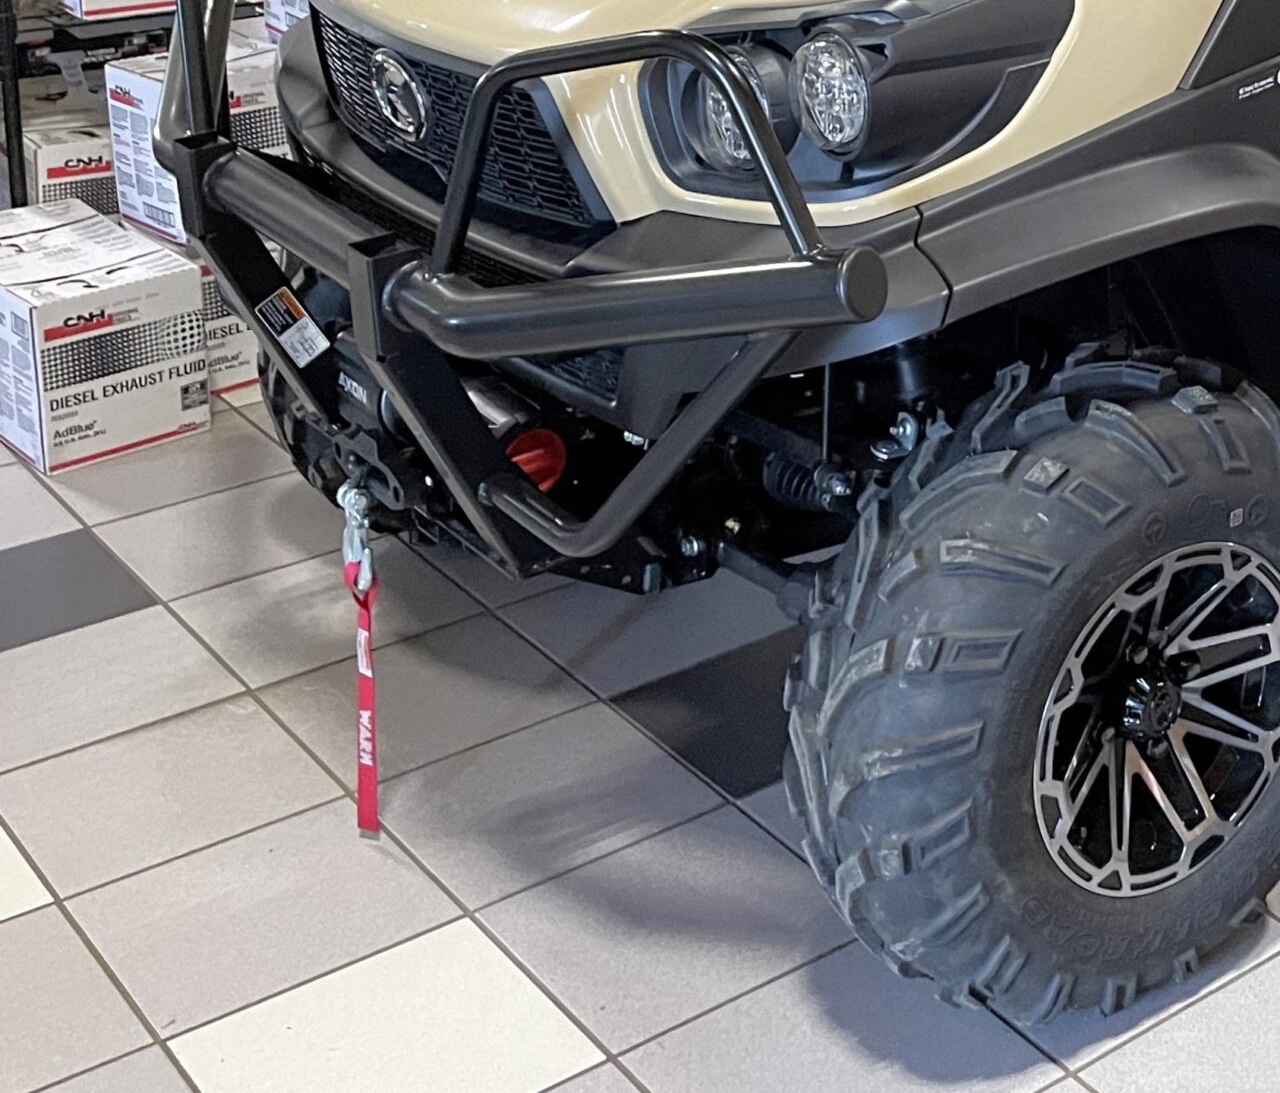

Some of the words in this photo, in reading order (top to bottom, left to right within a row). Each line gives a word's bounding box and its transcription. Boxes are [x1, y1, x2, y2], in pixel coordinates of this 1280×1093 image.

[64, 155, 103, 169] CNH
[63, 310, 105, 328] CNH
[208, 322, 244, 340] IESEL
[209, 351, 241, 368] dBlue
[50, 390, 99, 412] DIESEL
[102, 370, 165, 398] EXHAUST
[168, 358, 207, 380] FLUID
[358, 709, 374, 766] WARN
